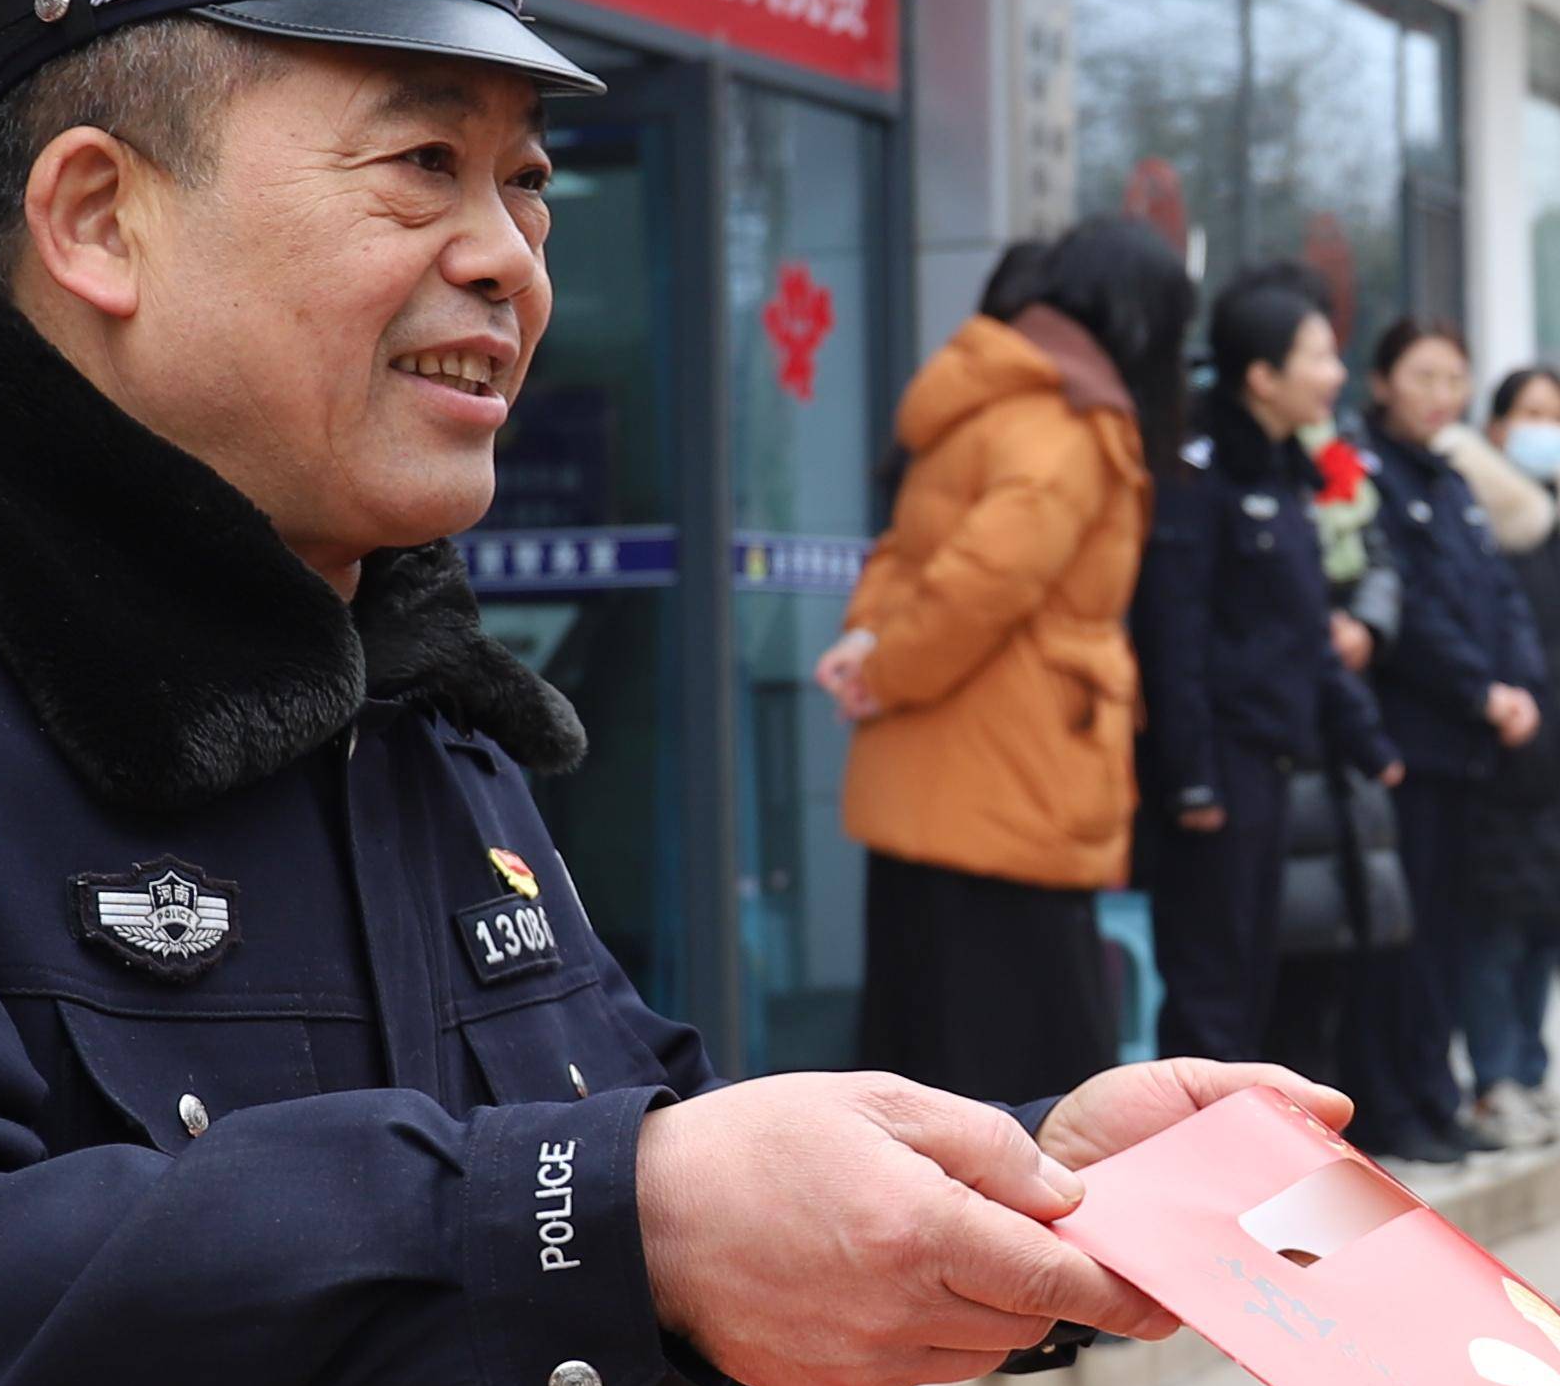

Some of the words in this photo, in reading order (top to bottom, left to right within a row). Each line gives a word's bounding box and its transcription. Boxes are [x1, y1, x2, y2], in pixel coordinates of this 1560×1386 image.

[156, 883, 190, 905] 河南
[156, 908, 194, 922] POLICE
[535, 1140, 581, 1271] POLICE
